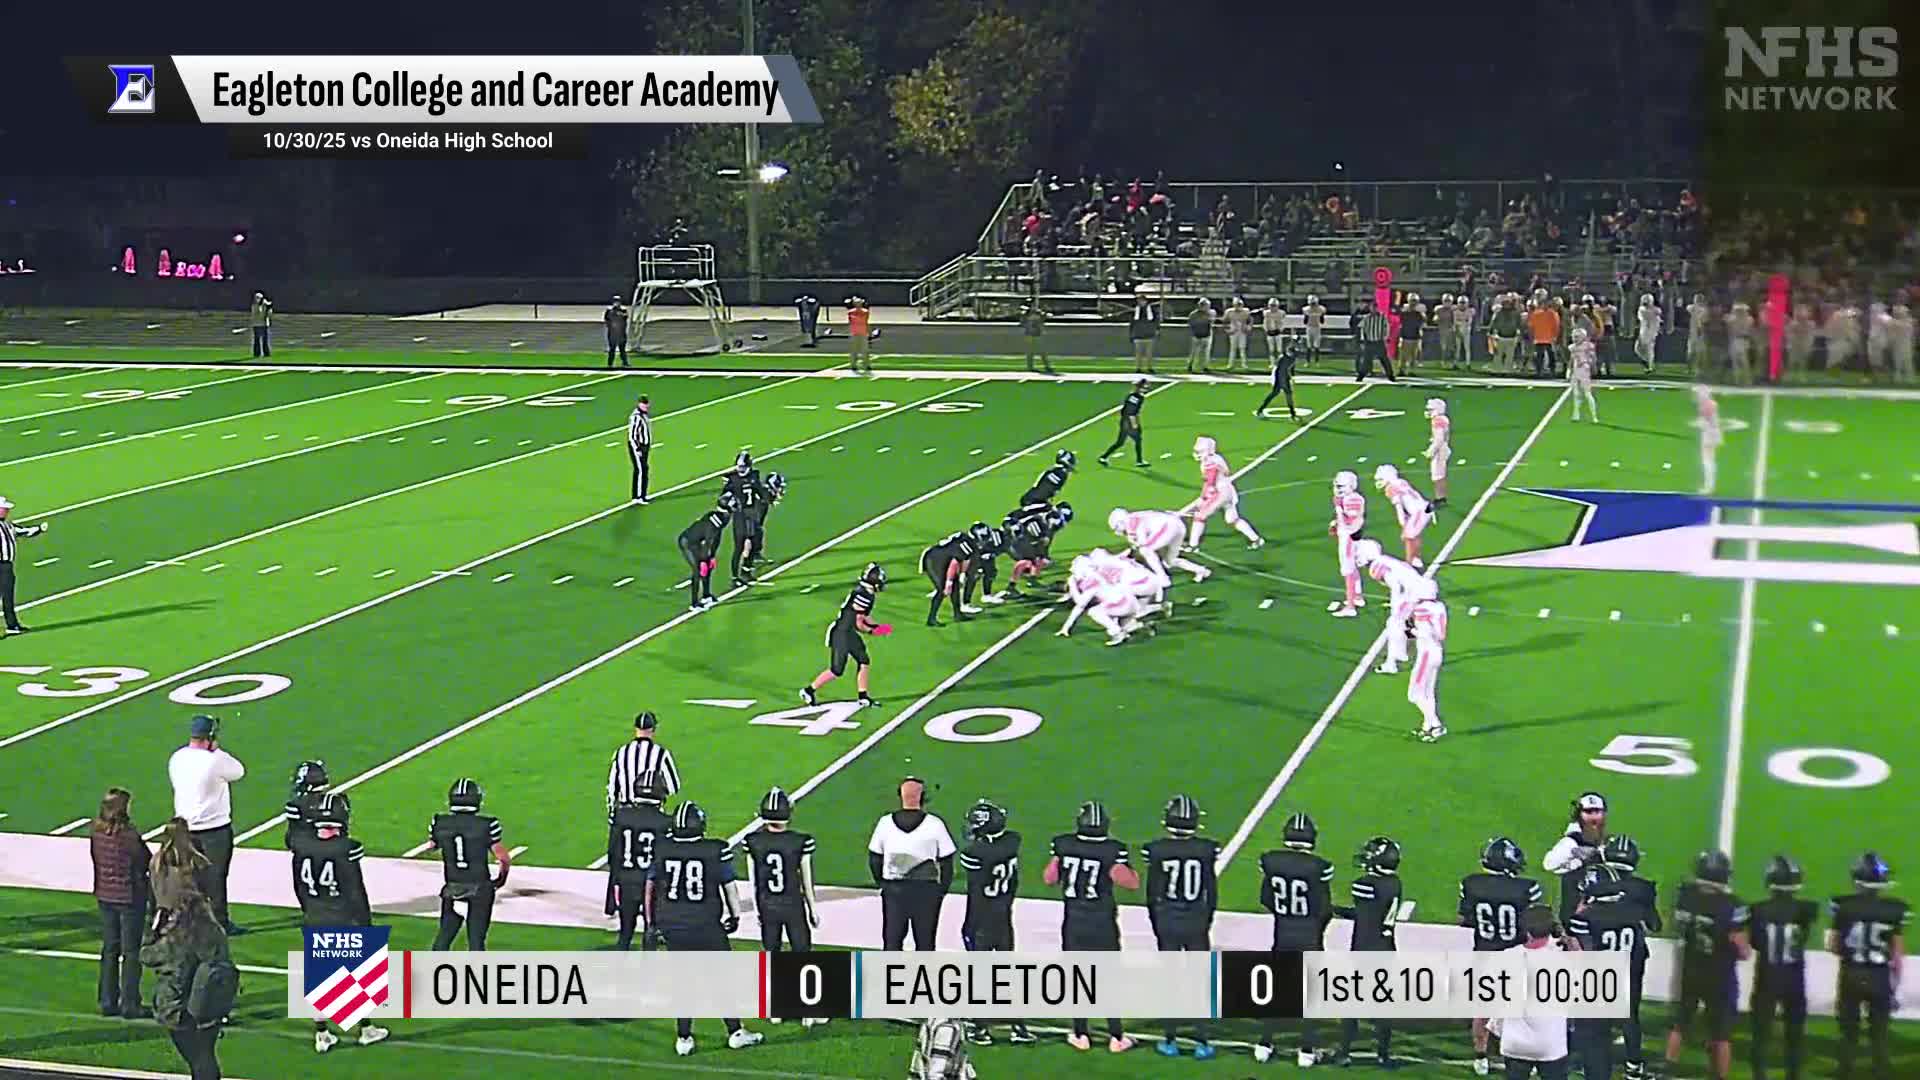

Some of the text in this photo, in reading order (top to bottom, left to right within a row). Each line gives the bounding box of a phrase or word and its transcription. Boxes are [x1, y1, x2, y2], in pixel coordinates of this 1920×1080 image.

[453, 835, 469, 870] 1
[622, 828, 656, 869] 13
[300, 857, 340, 897] 44
[665, 859, 704, 901] 78
[766, 852, 785, 893] 3
[1062, 855, 1101, 899] 77
[1162, 859, 1202, 901] 70
[1271, 875, 1309, 917] 26
